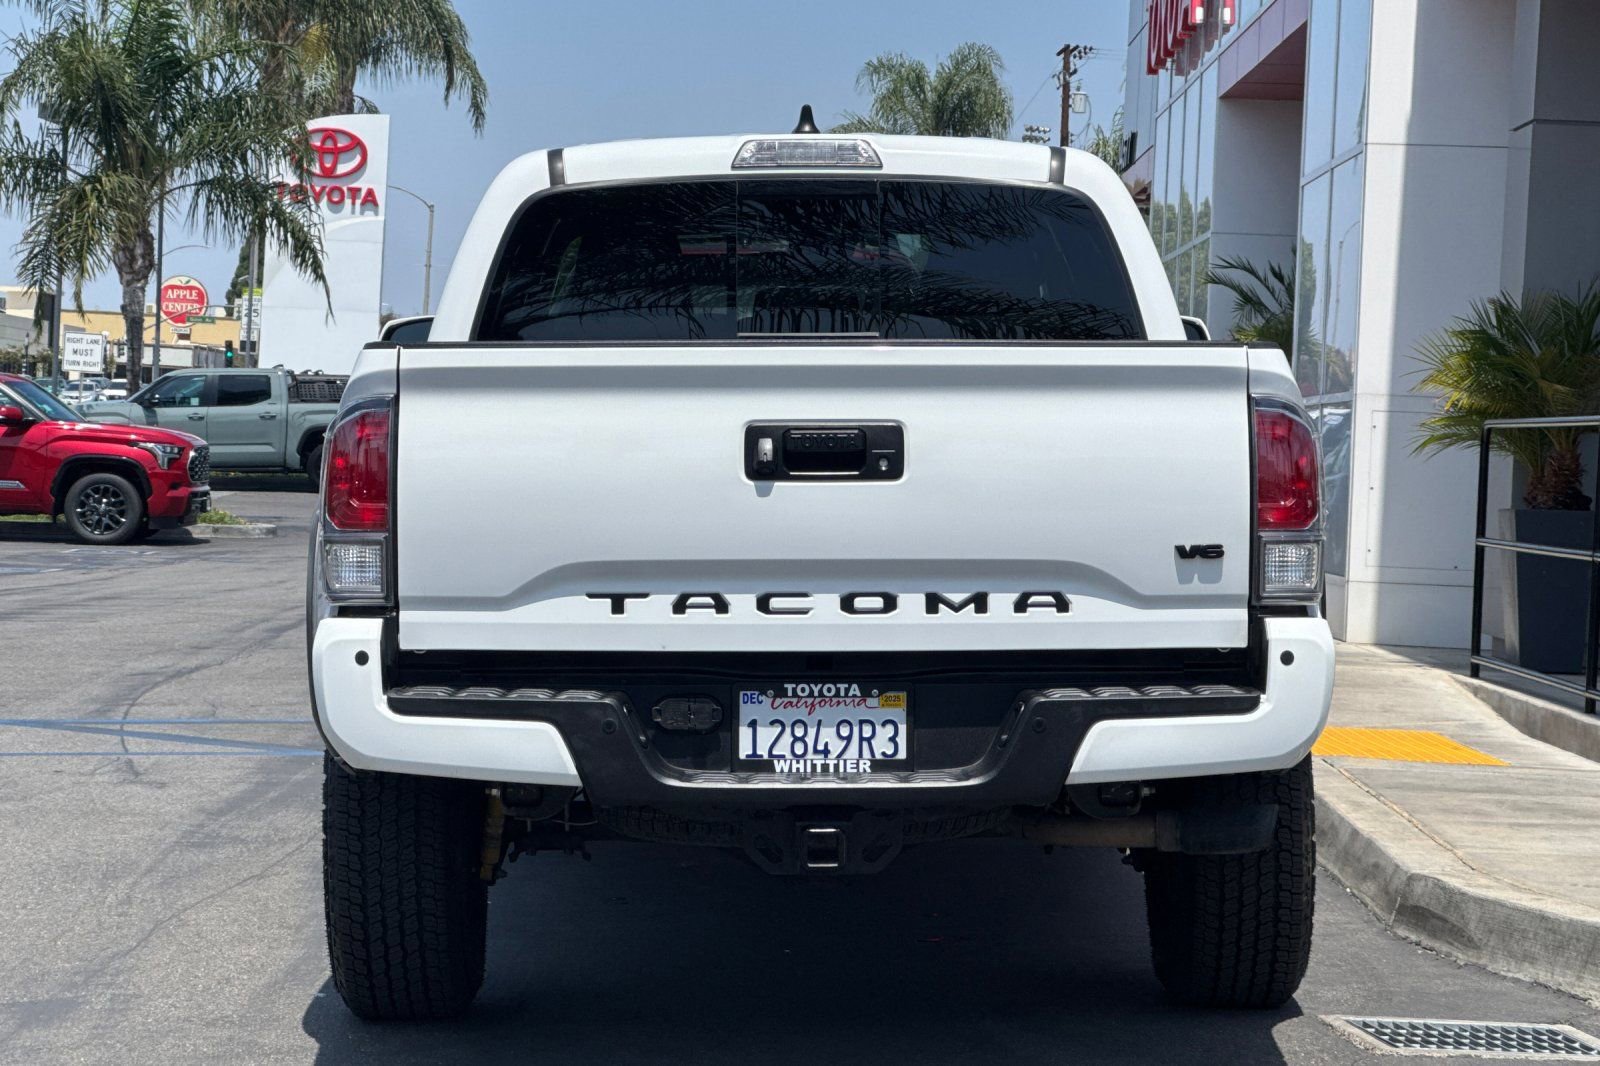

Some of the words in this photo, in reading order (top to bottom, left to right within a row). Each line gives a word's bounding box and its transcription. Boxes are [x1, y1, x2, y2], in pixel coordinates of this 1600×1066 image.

[166, 289, 199, 300] APPLE
[162, 301, 200, 313] CENTER
[72, 348, 94, 357] MUST
[82, 360, 100, 368] RIGHT
[790, 434, 856, 448] TOYOTA
[1174, 544, 1225, 560] V6
[585, 591, 1073, 615] TACOMA
[784, 683, 861, 697] TOYOTA
[742, 692, 764, 705] DEC
[884, 694, 902, 703] 2025
[770, 696, 880, 716] California
[745, 718, 900, 759] 12849R3
[773, 759, 872, 773] WHITTIER
